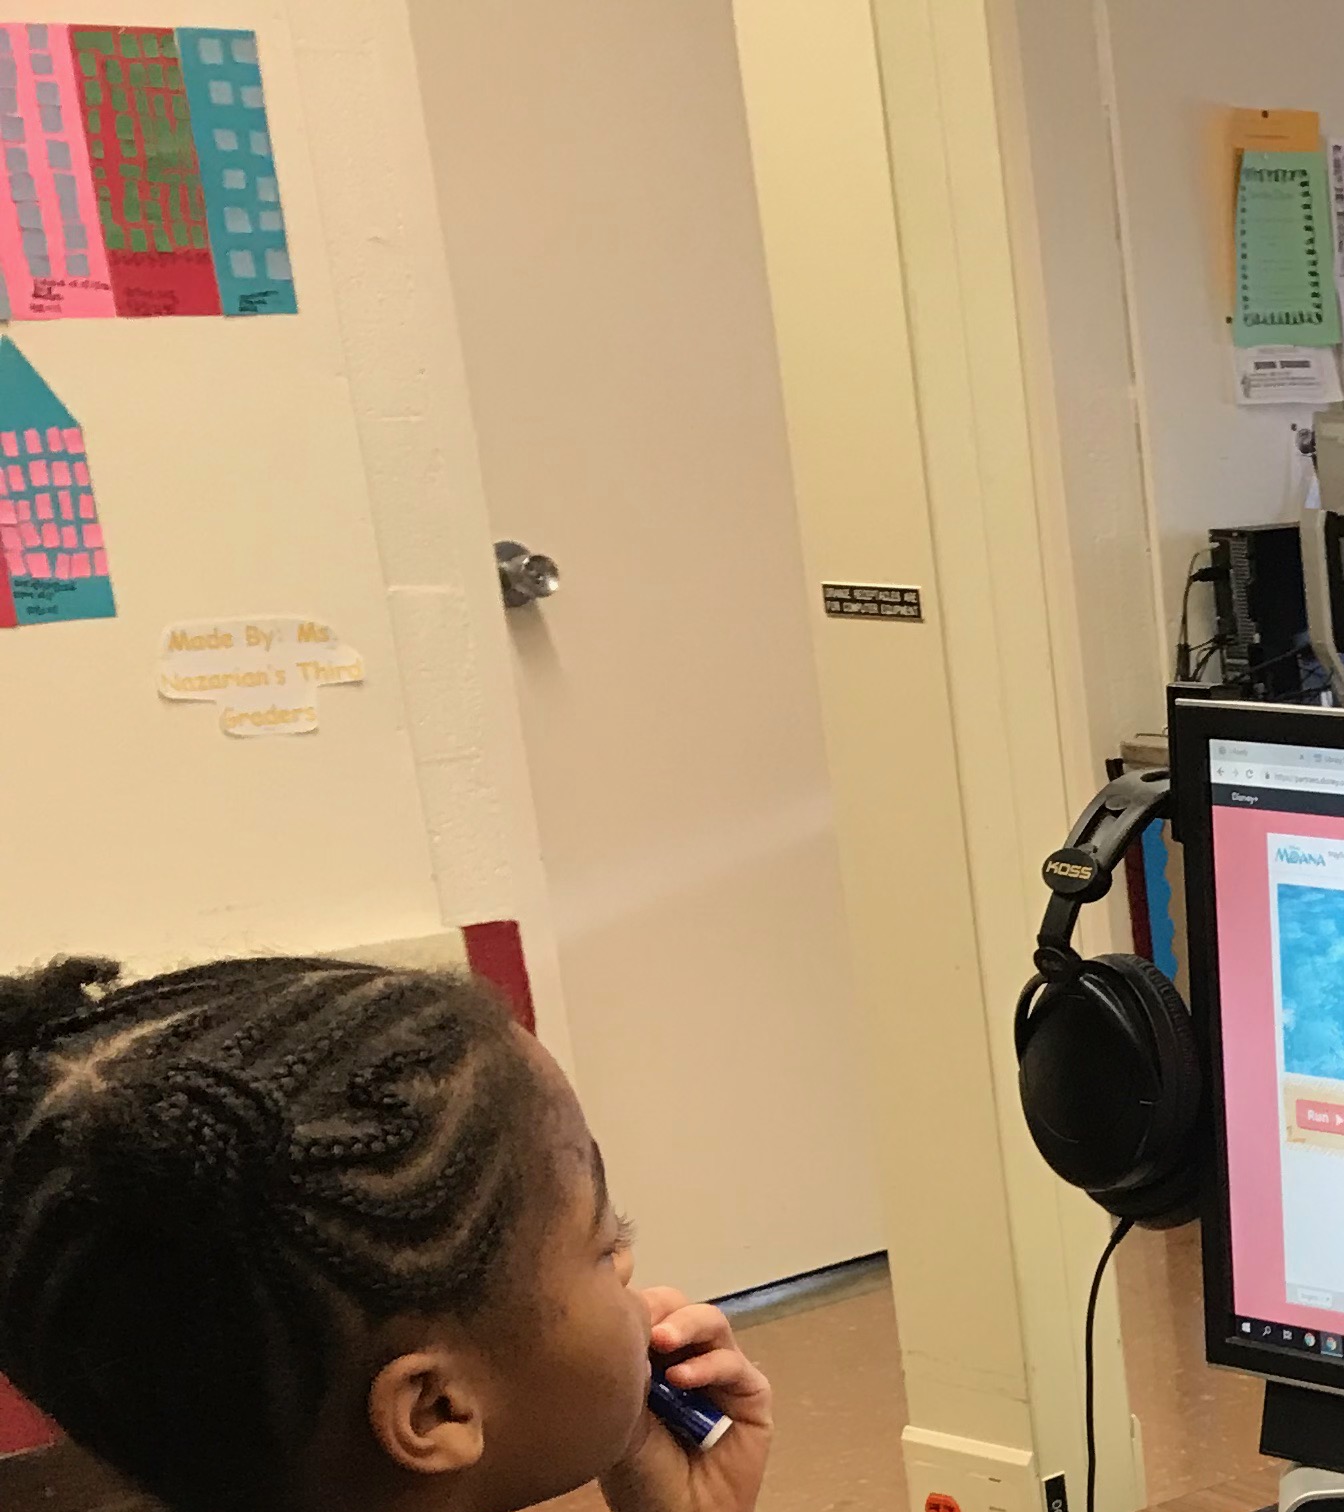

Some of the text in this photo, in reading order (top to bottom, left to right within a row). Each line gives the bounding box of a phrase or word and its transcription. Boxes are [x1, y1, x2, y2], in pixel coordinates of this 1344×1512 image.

[168, 627, 234, 650] Made
[296, 658, 365, 682] Third
[221, 703, 317, 728] Graders
[1276, 847, 1326, 867] MOANA
[1045, 860, 1094, 880] KOSS
[1307, 1110, 1330, 1123] Run
